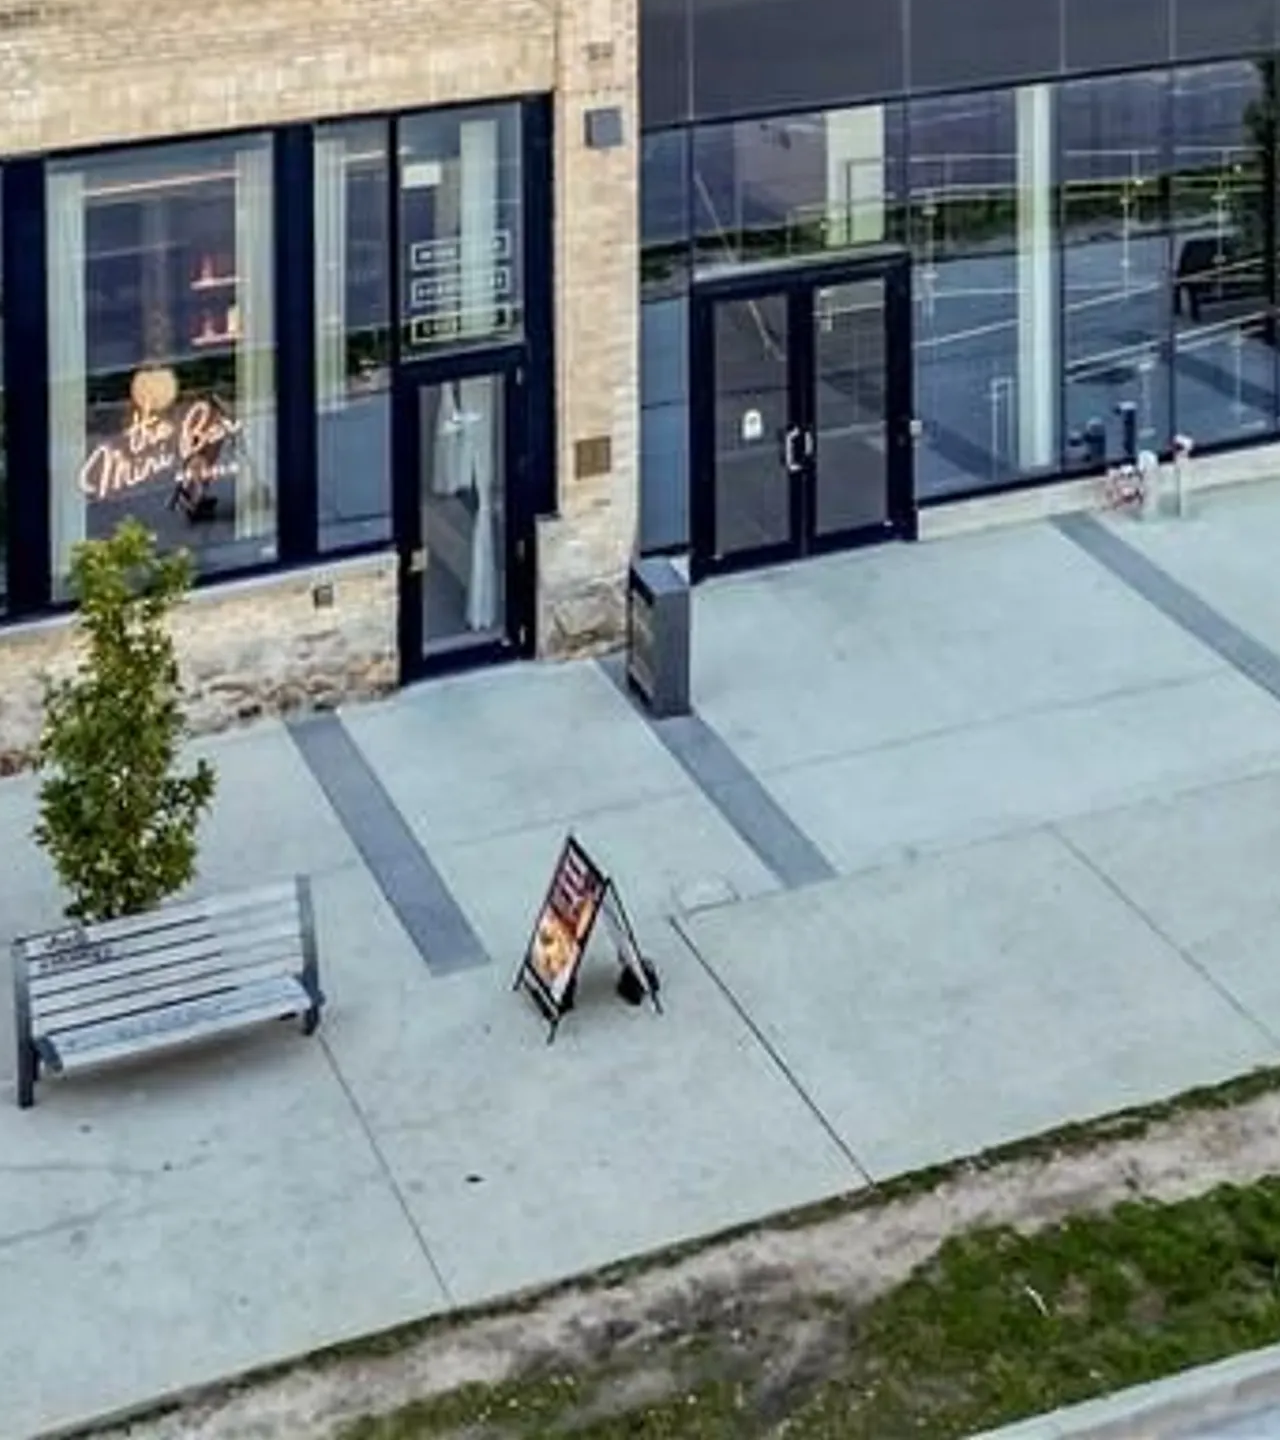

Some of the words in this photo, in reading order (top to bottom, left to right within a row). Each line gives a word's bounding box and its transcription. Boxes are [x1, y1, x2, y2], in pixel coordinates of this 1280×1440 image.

[79, 443, 175, 499] Mini
[178, 400, 242, 460] Bar
[124, 398, 173, 454] the
